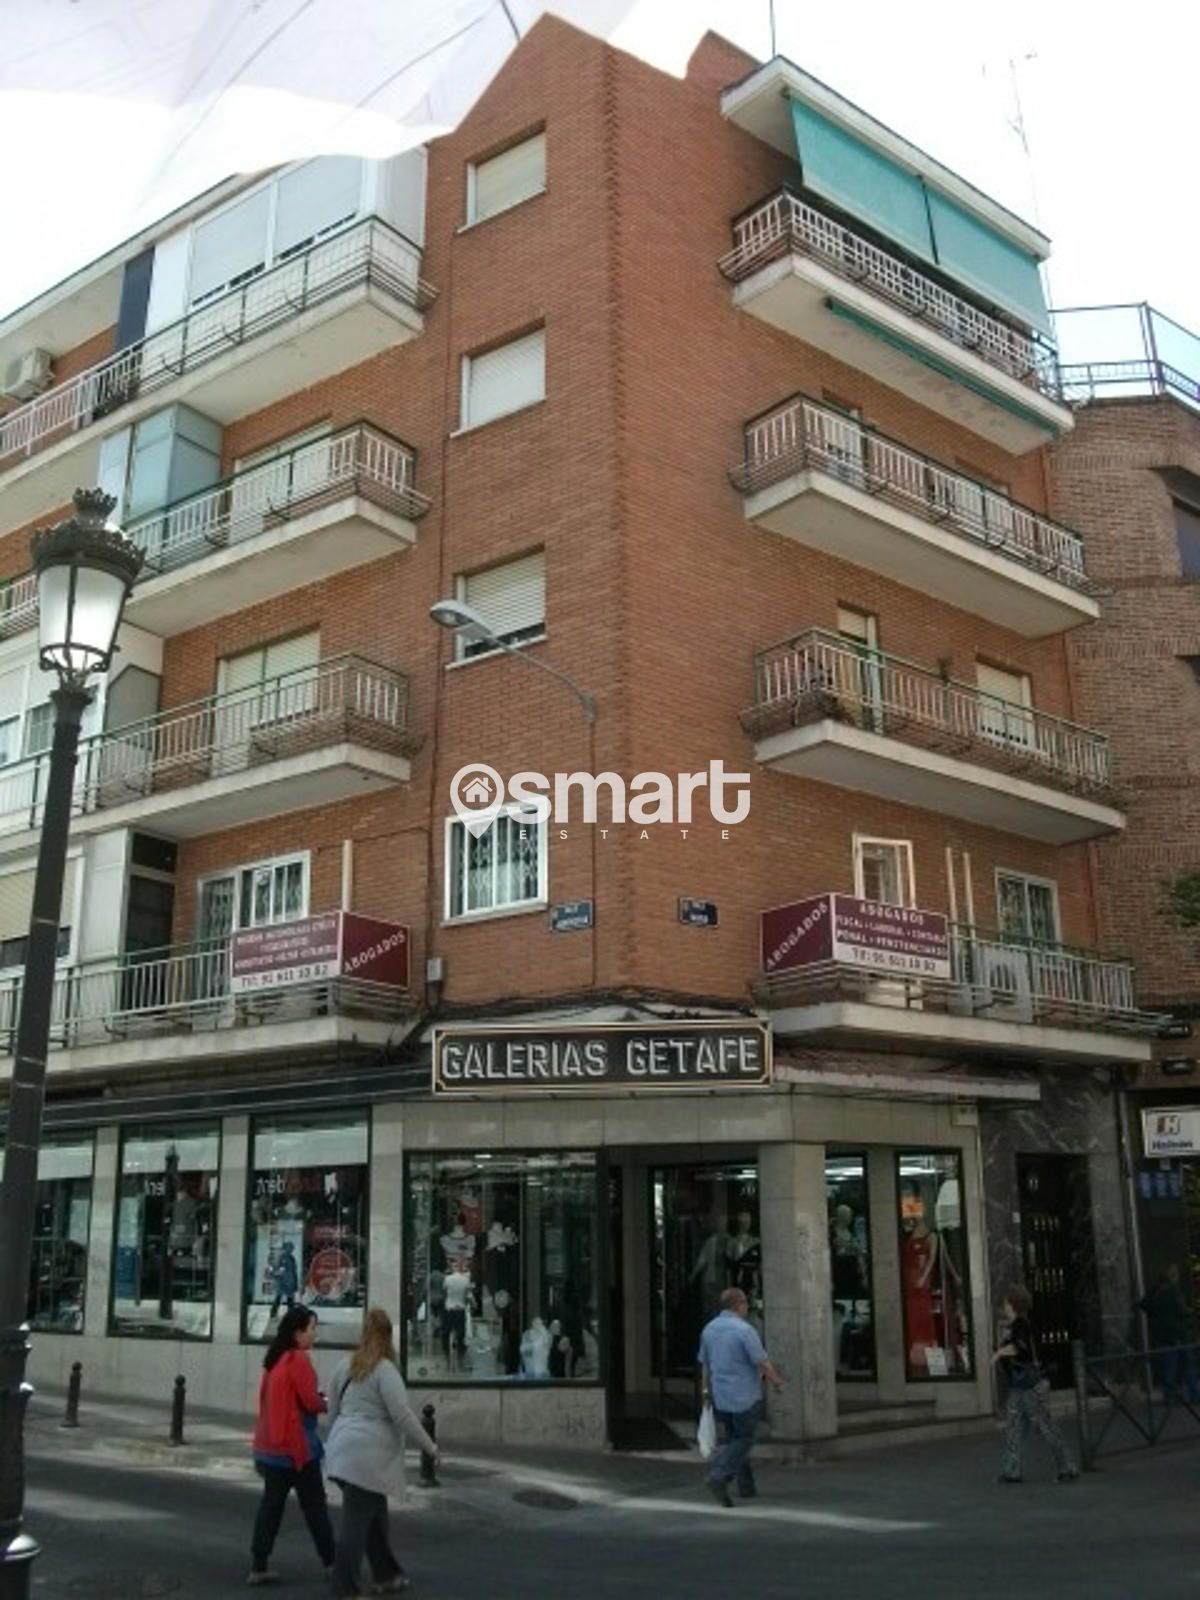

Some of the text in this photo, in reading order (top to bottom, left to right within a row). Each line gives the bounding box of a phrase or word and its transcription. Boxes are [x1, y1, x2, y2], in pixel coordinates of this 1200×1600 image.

[343, 929, 406, 974] ABOGADOS
[766, 902, 828, 970] ABOGADOS
[440, 1036, 760, 1079] GALERIAS GETAFE
